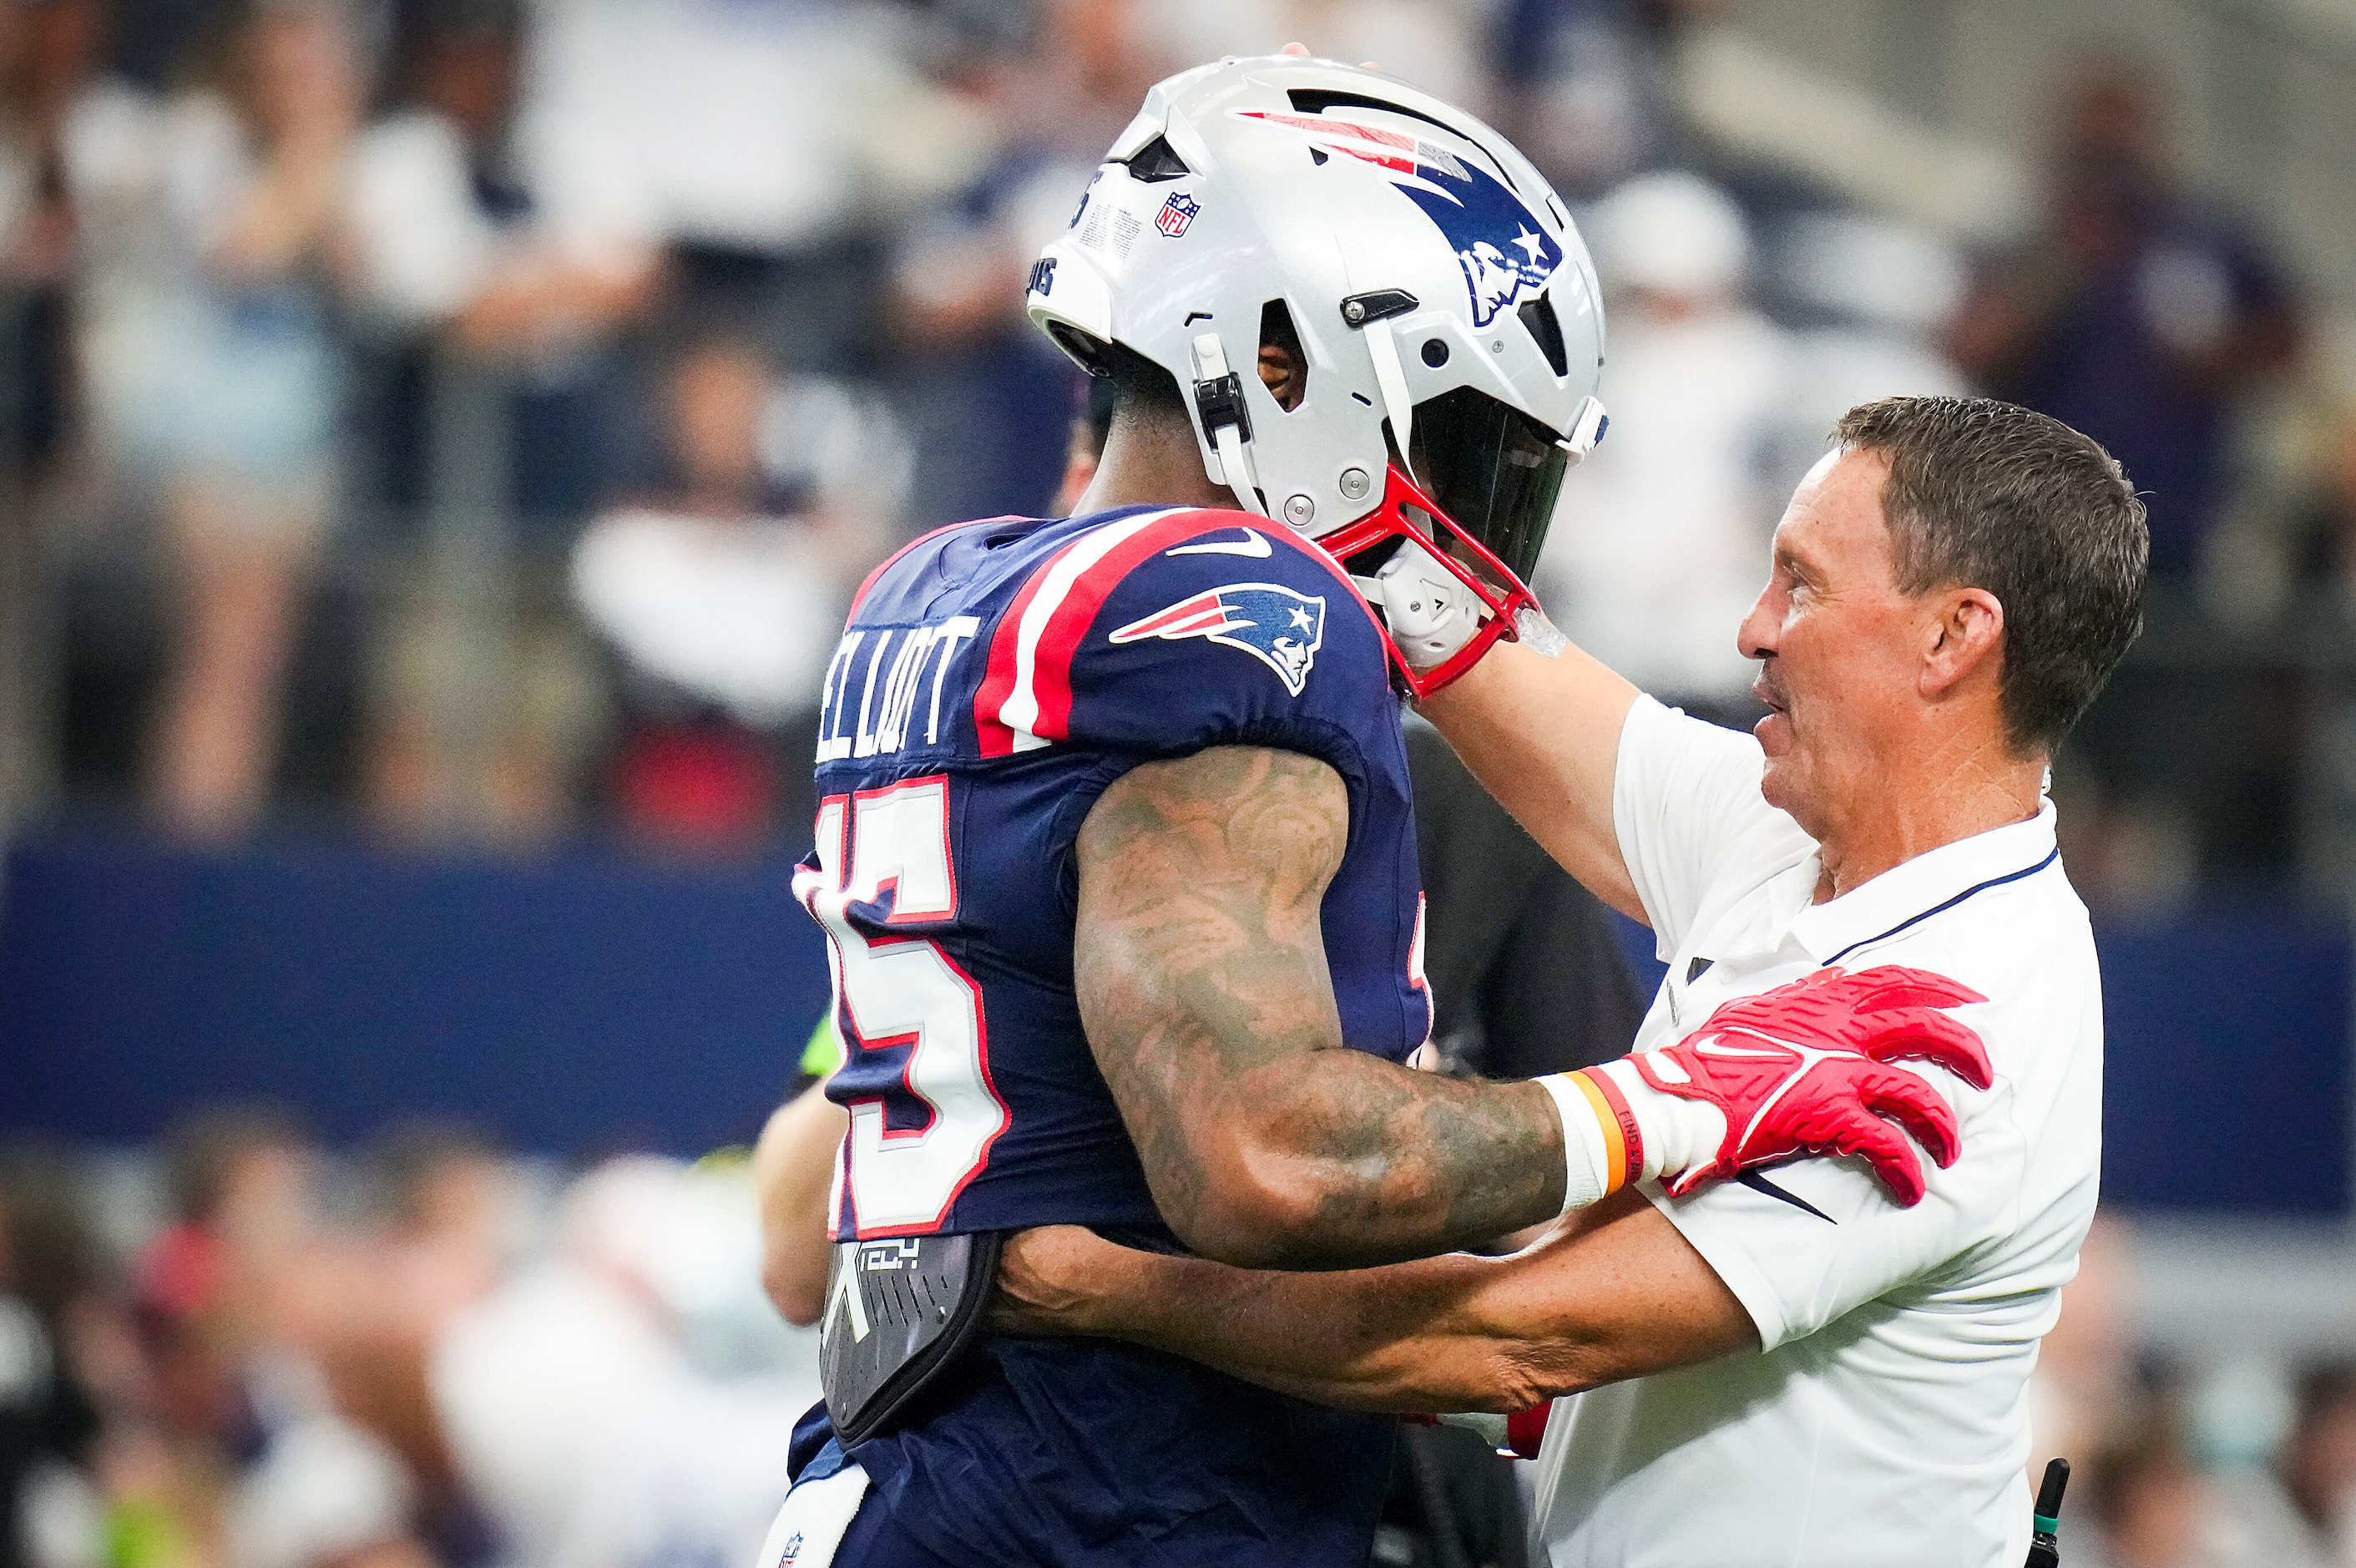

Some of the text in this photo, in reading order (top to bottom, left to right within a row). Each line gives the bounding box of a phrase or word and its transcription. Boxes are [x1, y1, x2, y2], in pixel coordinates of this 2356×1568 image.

[1158, 206, 1186, 234] NFL
[816, 616, 981, 764] ELLIOTT
[791, 773, 1012, 1242] 15
[1619, 1111, 1640, 1146] FIND
[1630, 1149, 1641, 1160] A
